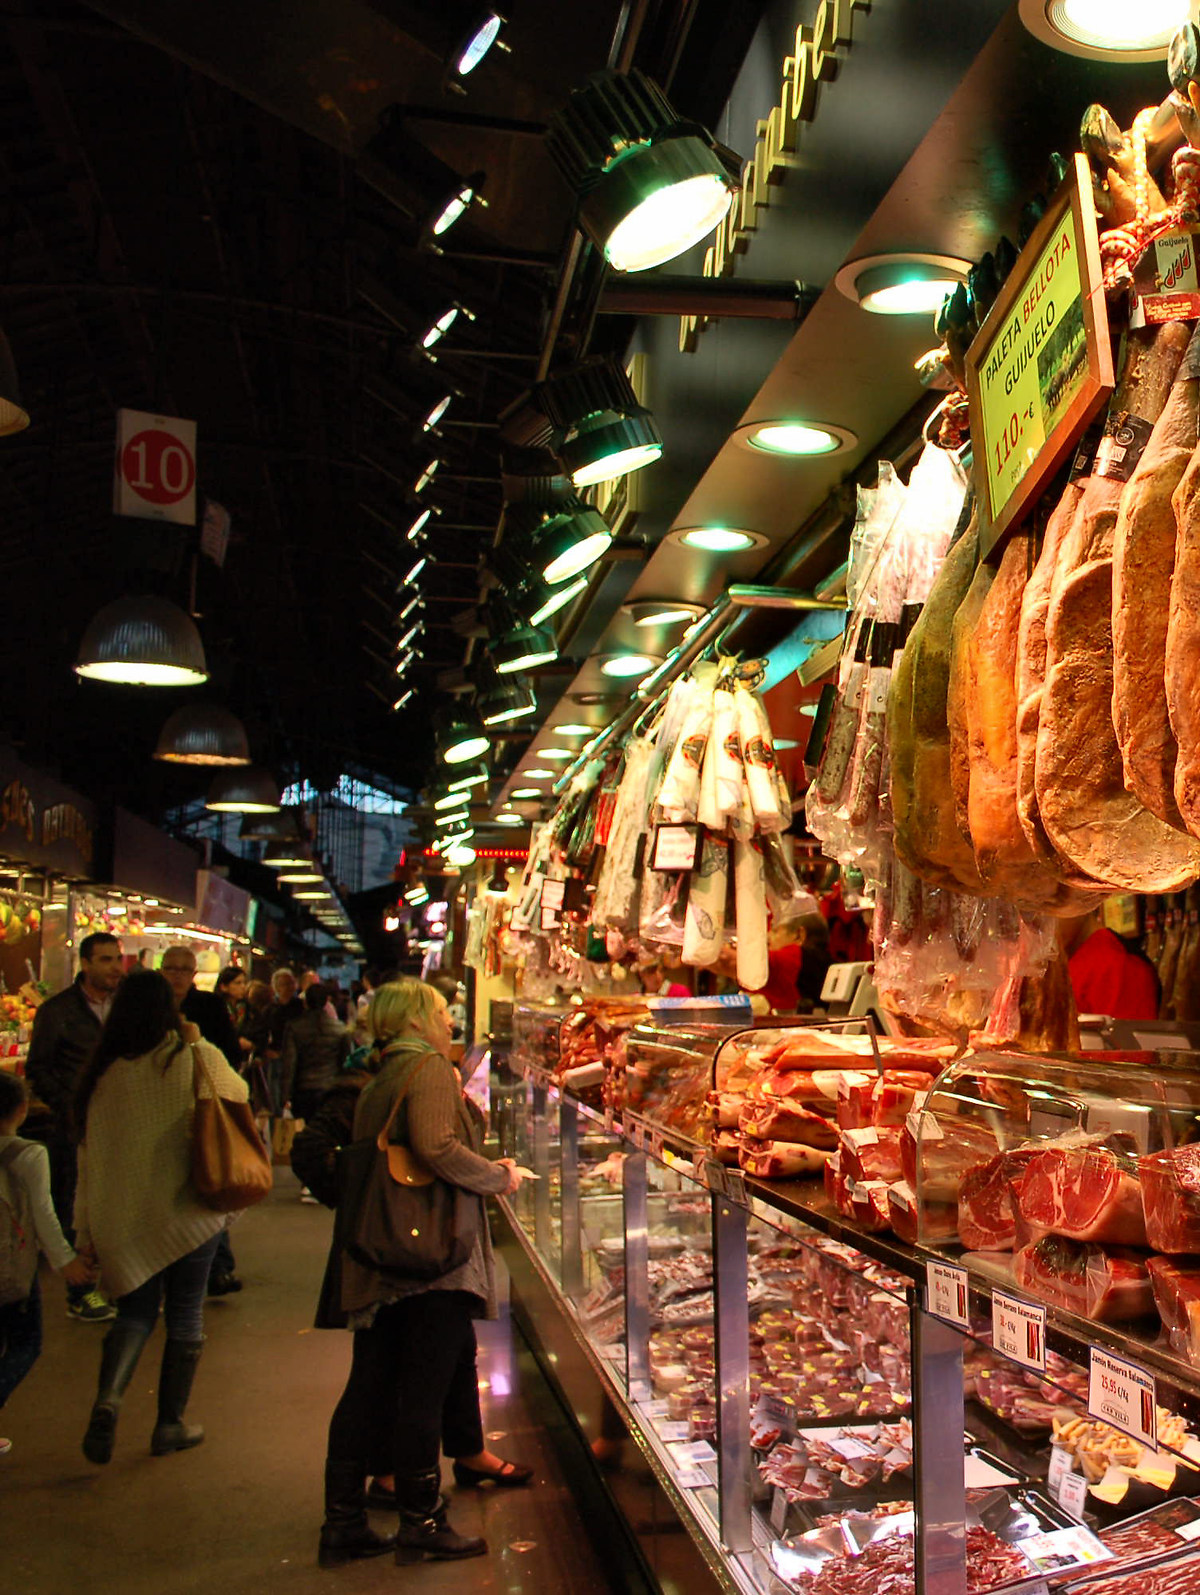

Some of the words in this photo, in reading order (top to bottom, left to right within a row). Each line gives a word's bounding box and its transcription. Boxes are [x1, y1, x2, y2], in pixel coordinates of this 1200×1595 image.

[1158, 237, 1189, 248] Guijuelo
[986, 317, 1021, 390] PALETA
[1023, 233, 1071, 324] BELLOTA
[1005, 300, 1055, 395] GUIJUELO
[131, 440, 189, 494] 10
